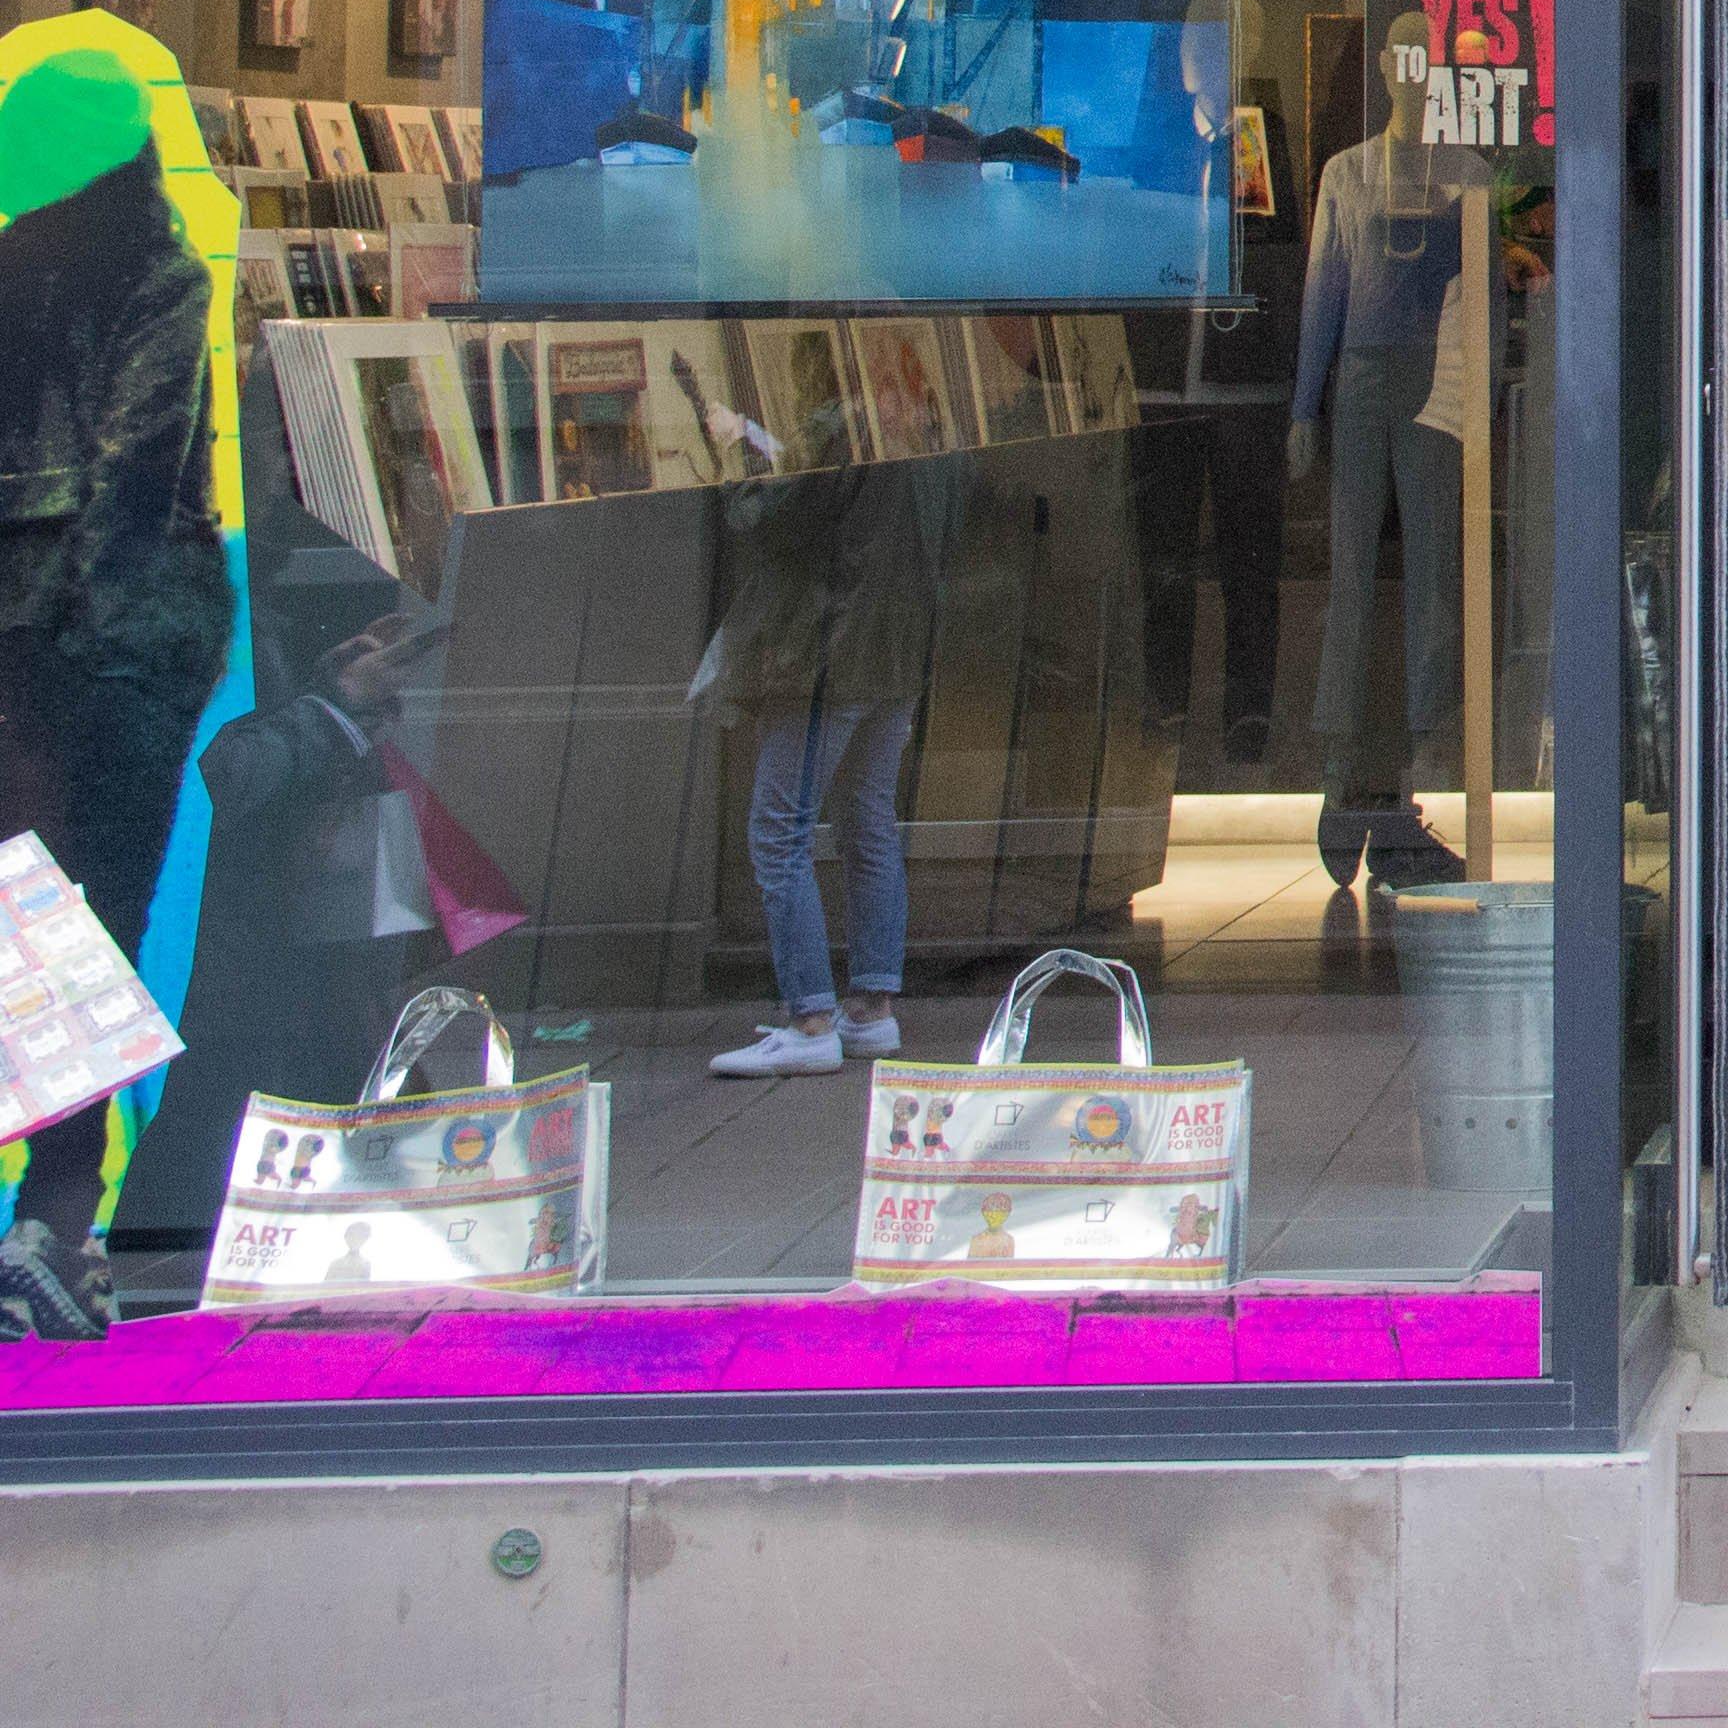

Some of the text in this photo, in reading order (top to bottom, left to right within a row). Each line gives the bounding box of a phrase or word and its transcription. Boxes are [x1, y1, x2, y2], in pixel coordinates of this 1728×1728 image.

[1393, 44, 1427, 84] TO
[1421, 66, 1529, 146] ART
[1171, 1101, 1226, 1127] ART
[1168, 1125, 1224, 1139] IS GOOD
[1167, 1136, 1224, 1151] FOR YOU
[876, 1197, 937, 1221] ART
[873, 1221, 935, 1233] IS GOOD
[234, 1224, 297, 1247] ART
[873, 1233, 934, 1245] FOR YOU
[247, 1246, 290, 1258] GOO
[227, 1255, 256, 1267] FOR
